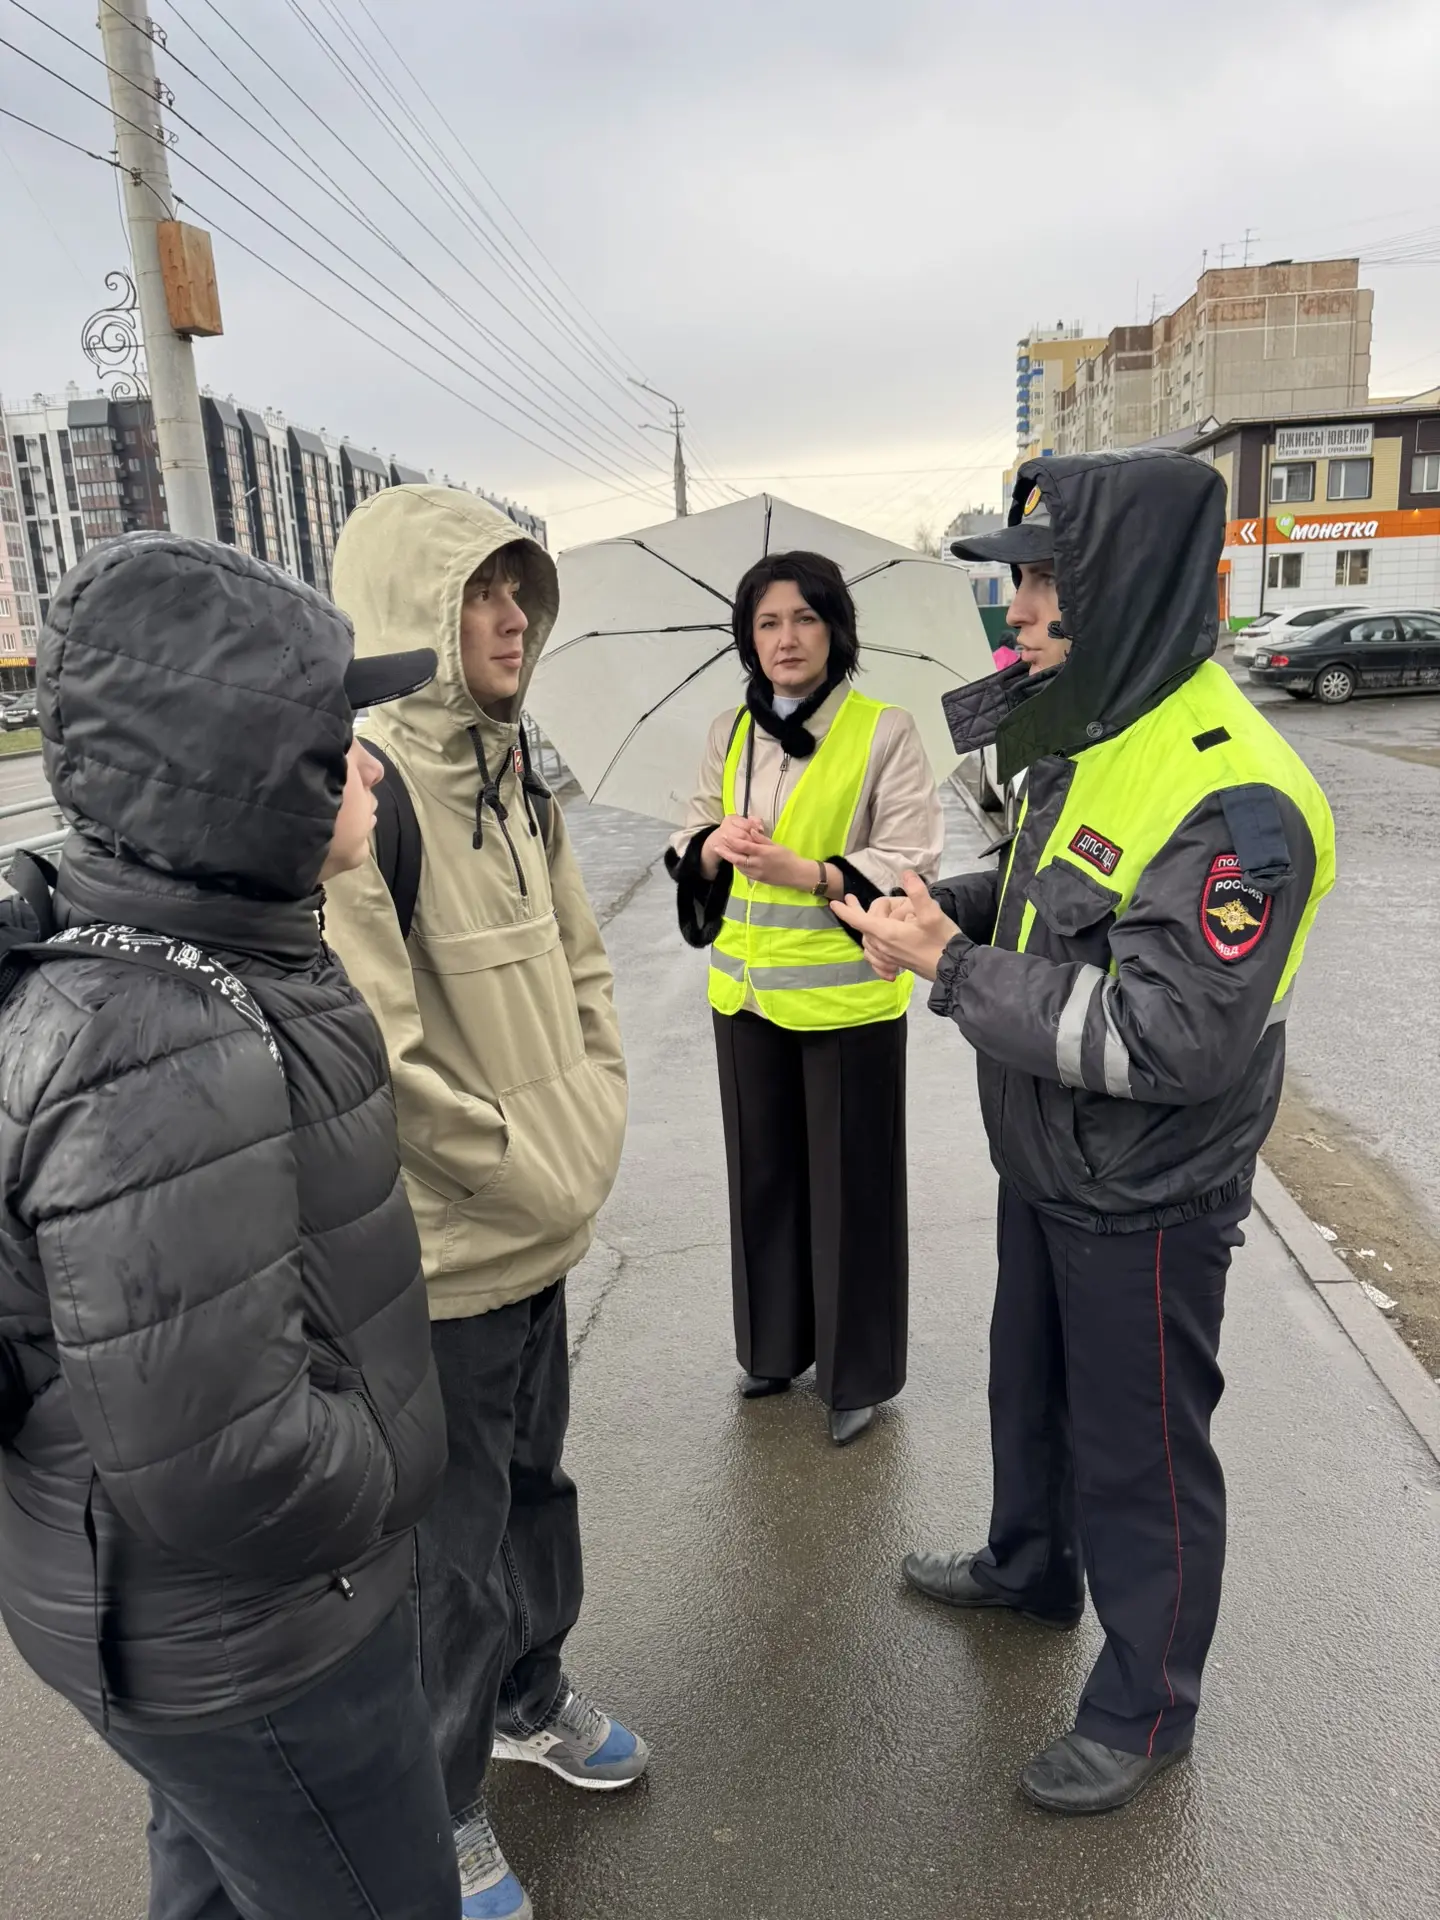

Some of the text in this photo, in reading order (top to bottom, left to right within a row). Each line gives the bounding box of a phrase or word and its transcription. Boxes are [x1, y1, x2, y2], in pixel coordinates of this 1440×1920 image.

[1278, 431, 1324, 449] ДЖИНСЫ
[1327, 428, 1369, 446] ЮВЕЛИР
[1077, 834, 1103, 855] ДПС
[1215, 880, 1264, 904] РОССИЯ
[1215, 939, 1239, 956] МВД
